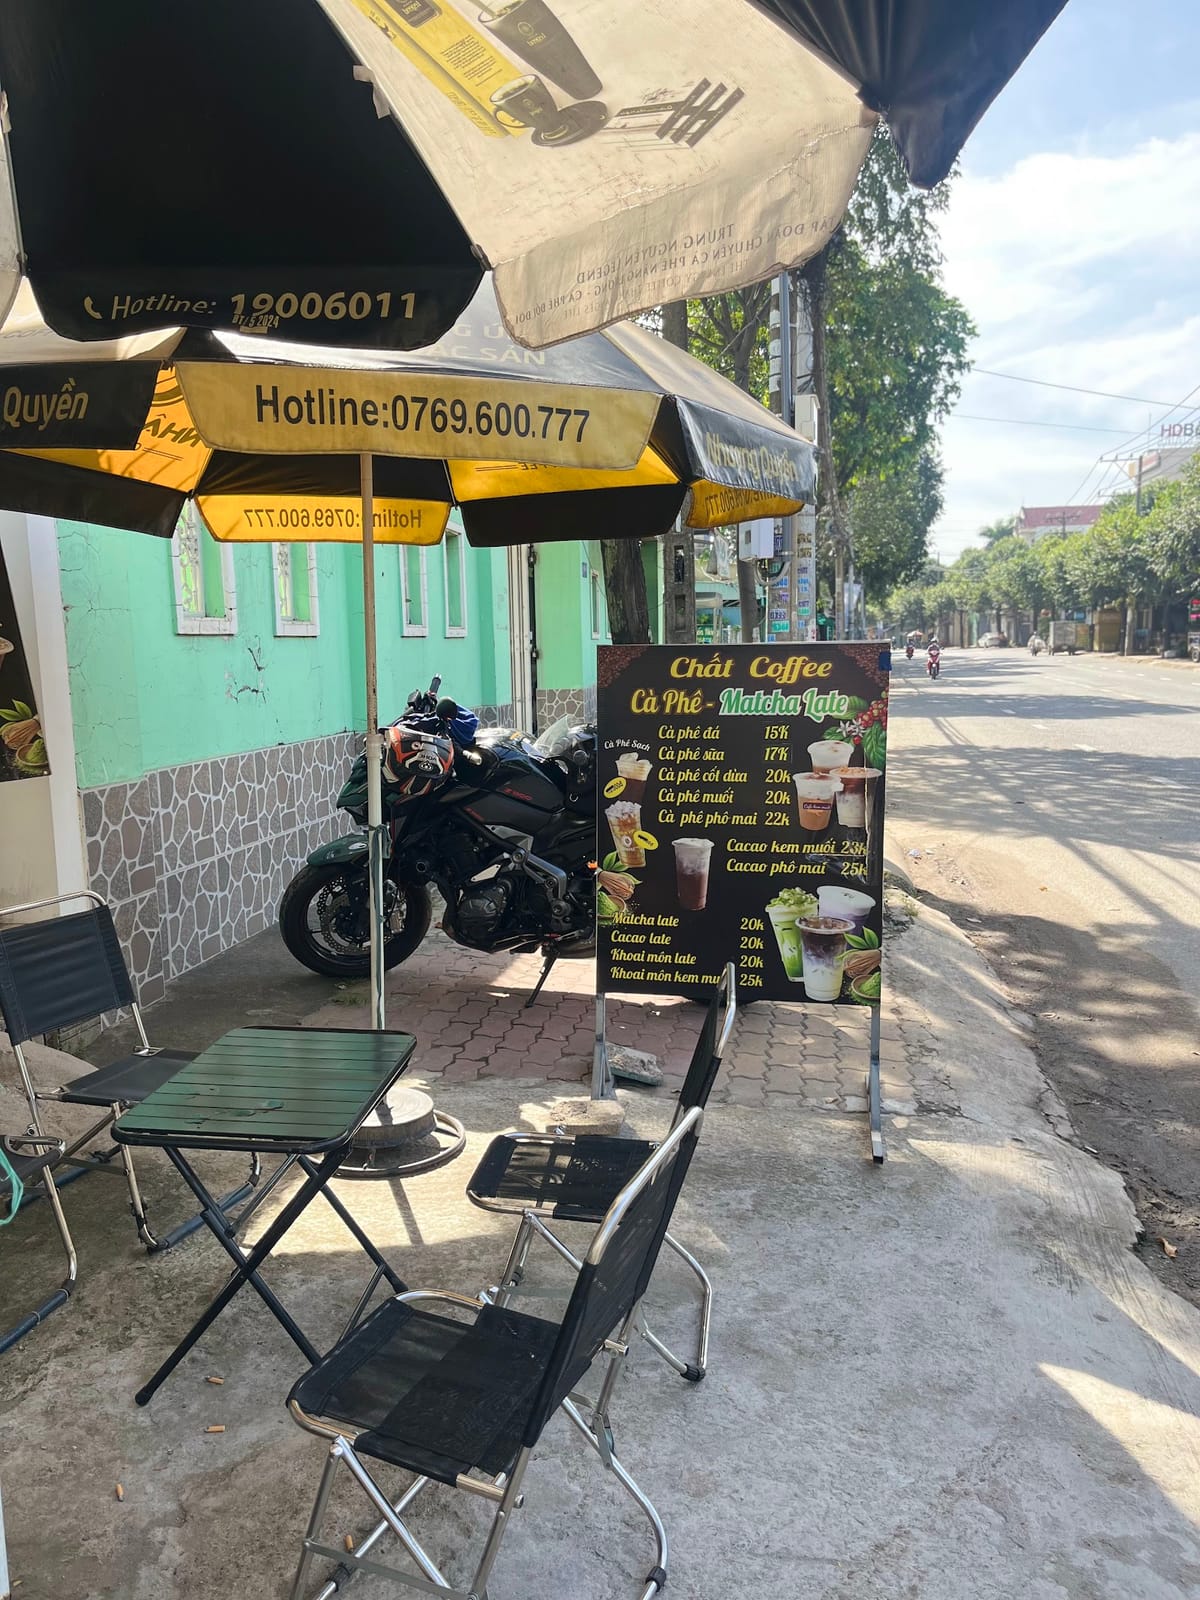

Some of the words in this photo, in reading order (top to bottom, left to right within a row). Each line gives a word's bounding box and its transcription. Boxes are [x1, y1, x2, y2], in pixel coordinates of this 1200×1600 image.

[110, 293, 217, 320] Hotline:
[230, 291, 416, 321] 19006011
[3, 377, 89, 431] Quyền
[255, 384, 590, 443] Hotline:0769.600.777
[706, 431, 760, 480] Nhượng
[670, 652, 735, 679] Chất
[749, 655, 833, 684] Coffee
[631, 688, 659, 714] Cà
[662, 688, 703, 714] Phê
[719, 687, 802, 716] Matcha
[803, 687, 849, 723] Late
[658, 724, 675, 739] Cà
[676, 726, 701, 743] phê
[702, 725, 720, 740] đá
[604, 740, 614, 750] Cà
[631, 739, 651, 752] Sạch
[658, 745, 675, 760] Cà
[676, 747, 701, 764] phê
[702, 747, 725, 761] sữa
[658, 766, 675, 781] Cà
[676, 768, 701, 785] phê
[702, 765, 720, 782] cốt
[722, 768, 748, 783] dừa
[765, 768, 791, 783] 20k
[658, 787, 675, 802] Cà
[676, 789, 701, 806] phê
[702, 786, 734, 804] muối
[764, 790, 791, 805] 20k
[658, 808, 675, 823] Cà
[679, 810, 704, 827] phê
[704, 811, 730, 828] phô
[731, 812, 757, 826] mai
[764, 811, 790, 827] 22k
[726, 838, 768, 853] Cacao
[770, 840, 800, 854] kem
[726, 858, 768, 873] Cacao
[769, 859, 799, 877] phô
[612, 911, 655, 926] Matcha
[656, 914, 680, 928] late
[740, 917, 765, 931] 20k
[610, 929, 647, 944] Cacao
[649, 932, 672, 945] late
[740, 936, 764, 950] 20k
[610, 948, 646, 962] Khoai
[646, 950, 672, 964] môn
[674, 951, 697, 965] late
[739, 954, 764, 969] 20k
[610, 966, 646, 980] Khoai
[646, 968, 672, 982] môn
[673, 970, 700, 984] kem
[701, 974, 721, 985] mu
[739, 973, 763, 987] 25k
